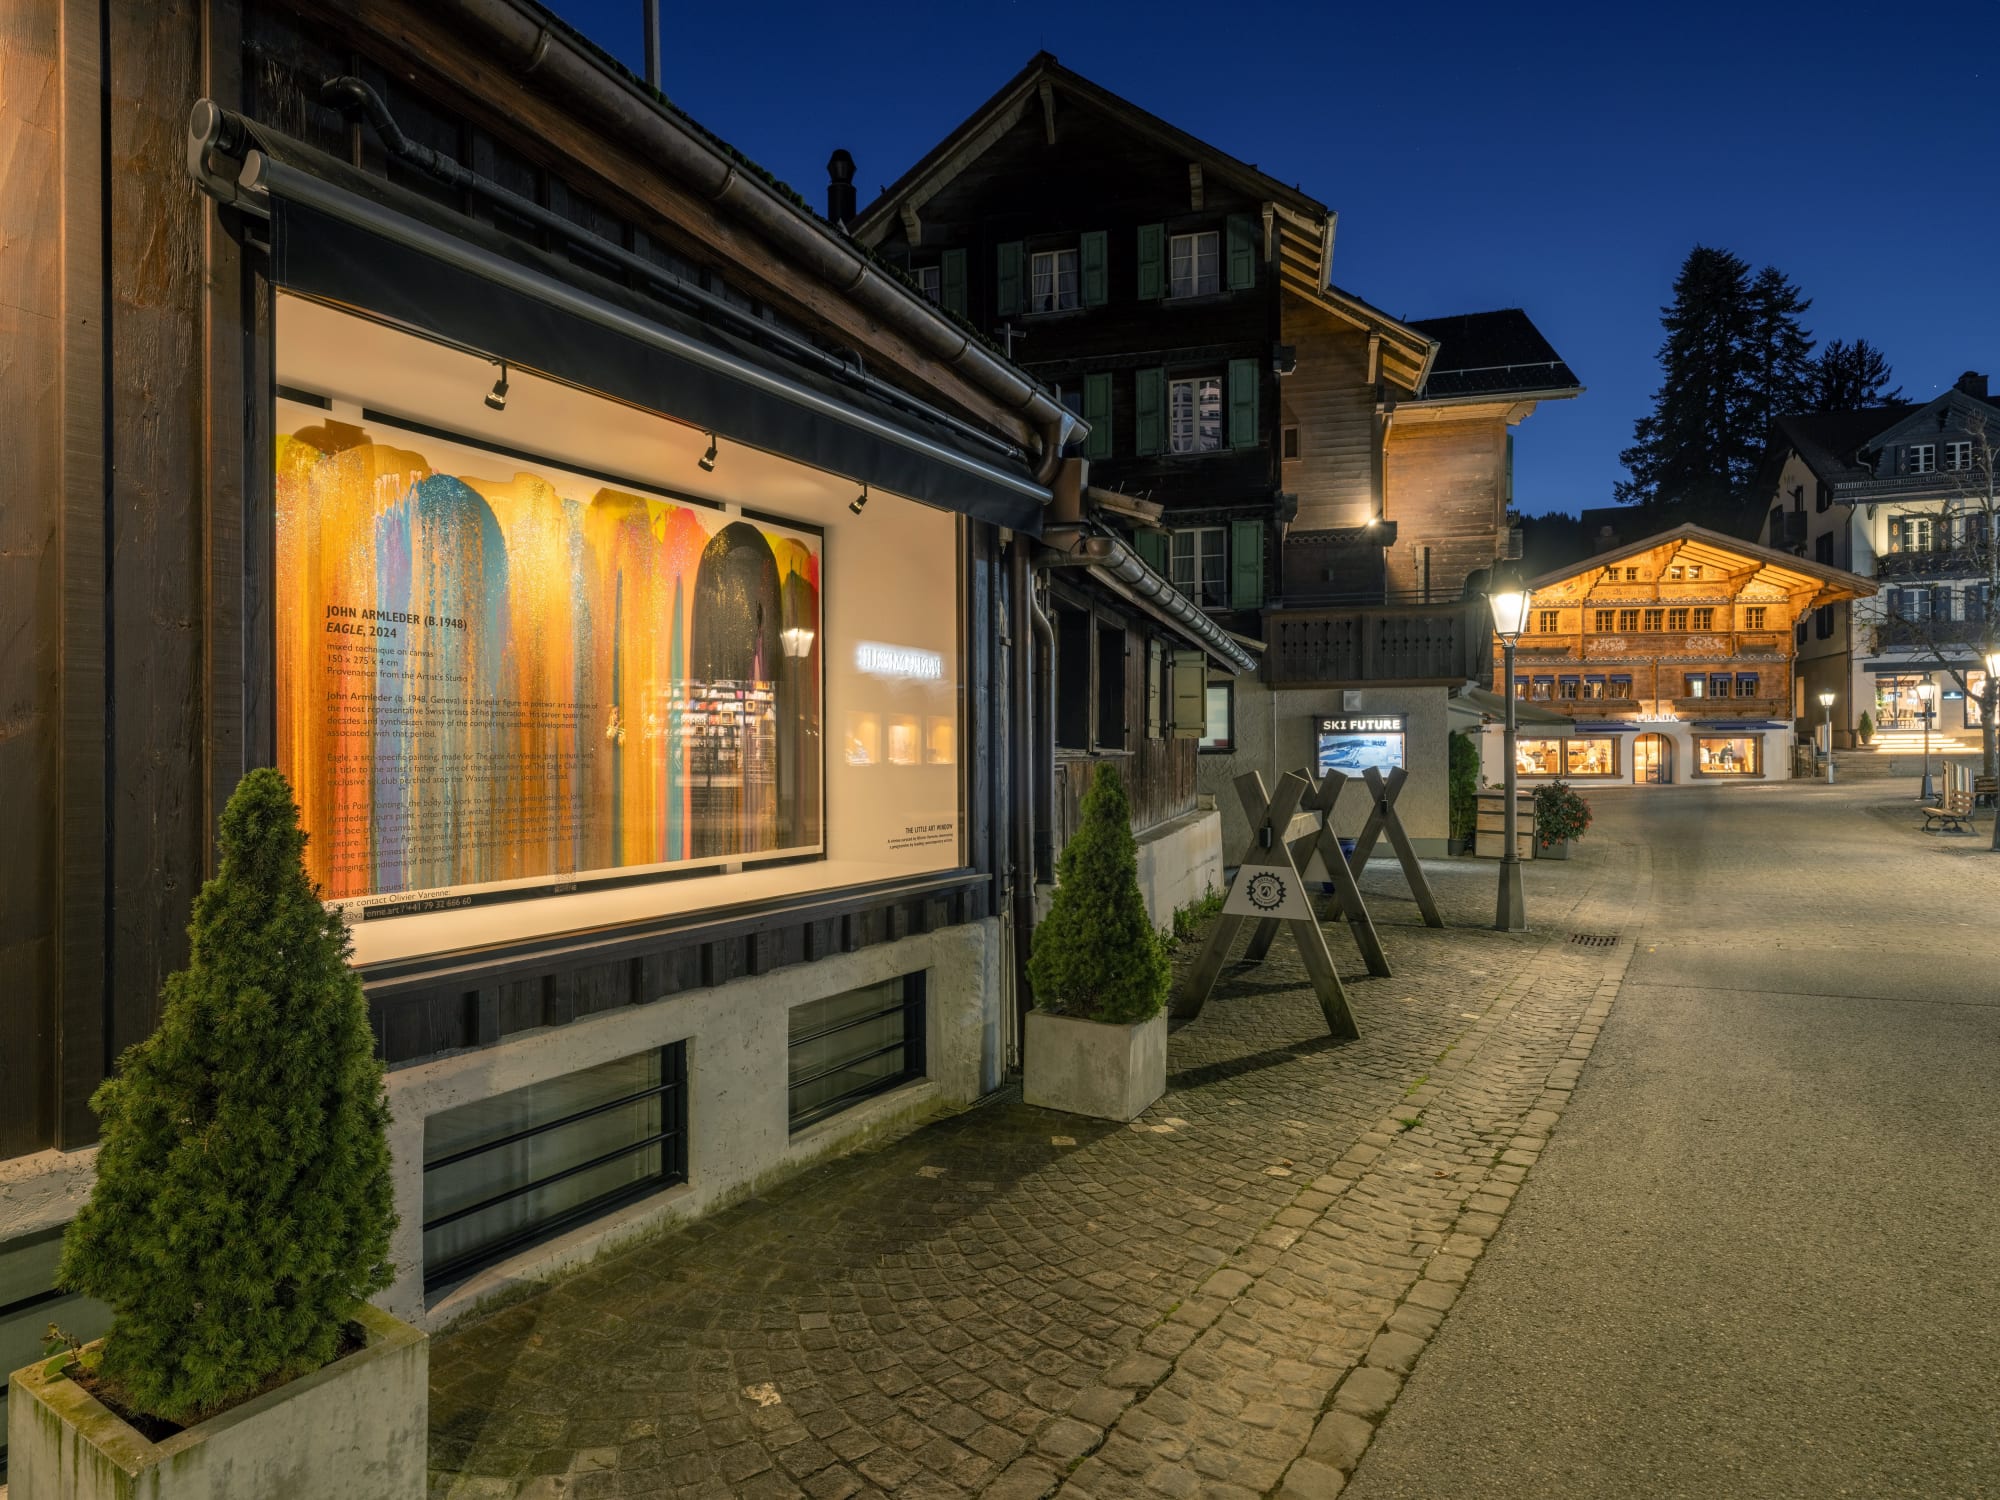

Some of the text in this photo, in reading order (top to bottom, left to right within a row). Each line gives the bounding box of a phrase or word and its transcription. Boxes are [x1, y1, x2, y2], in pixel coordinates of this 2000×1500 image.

[326, 605, 468, 631] JOHN ARMLEDER (B.1948)
[326, 622, 397, 638] EAGLE, 2024
[327, 643, 352, 651] mixed
[356, 645, 395, 656] technique
[328, 654, 343, 663] 150
[354, 656, 368, 665] 275
[380, 669, 399, 679] from
[401, 671, 414, 680] the
[327, 692, 347, 702] John
[350, 692, 392, 702] Armleder
[430, 695, 460, 704] Geneva)
[367, 707, 423, 715] representative
[425, 706, 446, 715] Swiss
[426, 720, 445, 729] many
[456, 719, 468, 727] the
[1323, 719, 1401, 730] SKI FUTURE
[441, 753, 461, 761] made
[463, 752, 474, 761] for
[470, 763, 483, 771] the
[381, 776, 398, 785] club
[352, 801, 370, 810] Pour
[914, 825, 928, 833] LITTLE
[327, 863, 364, 874] changing
[419, 856, 433, 864] the
[351, 887, 372, 897] upon
[375, 883, 405, 894] request
[327, 889, 451, 910] Please contact Olivier Varenne:
[424, 901, 434, 910] 79
[462, 896, 472, 905] 60
